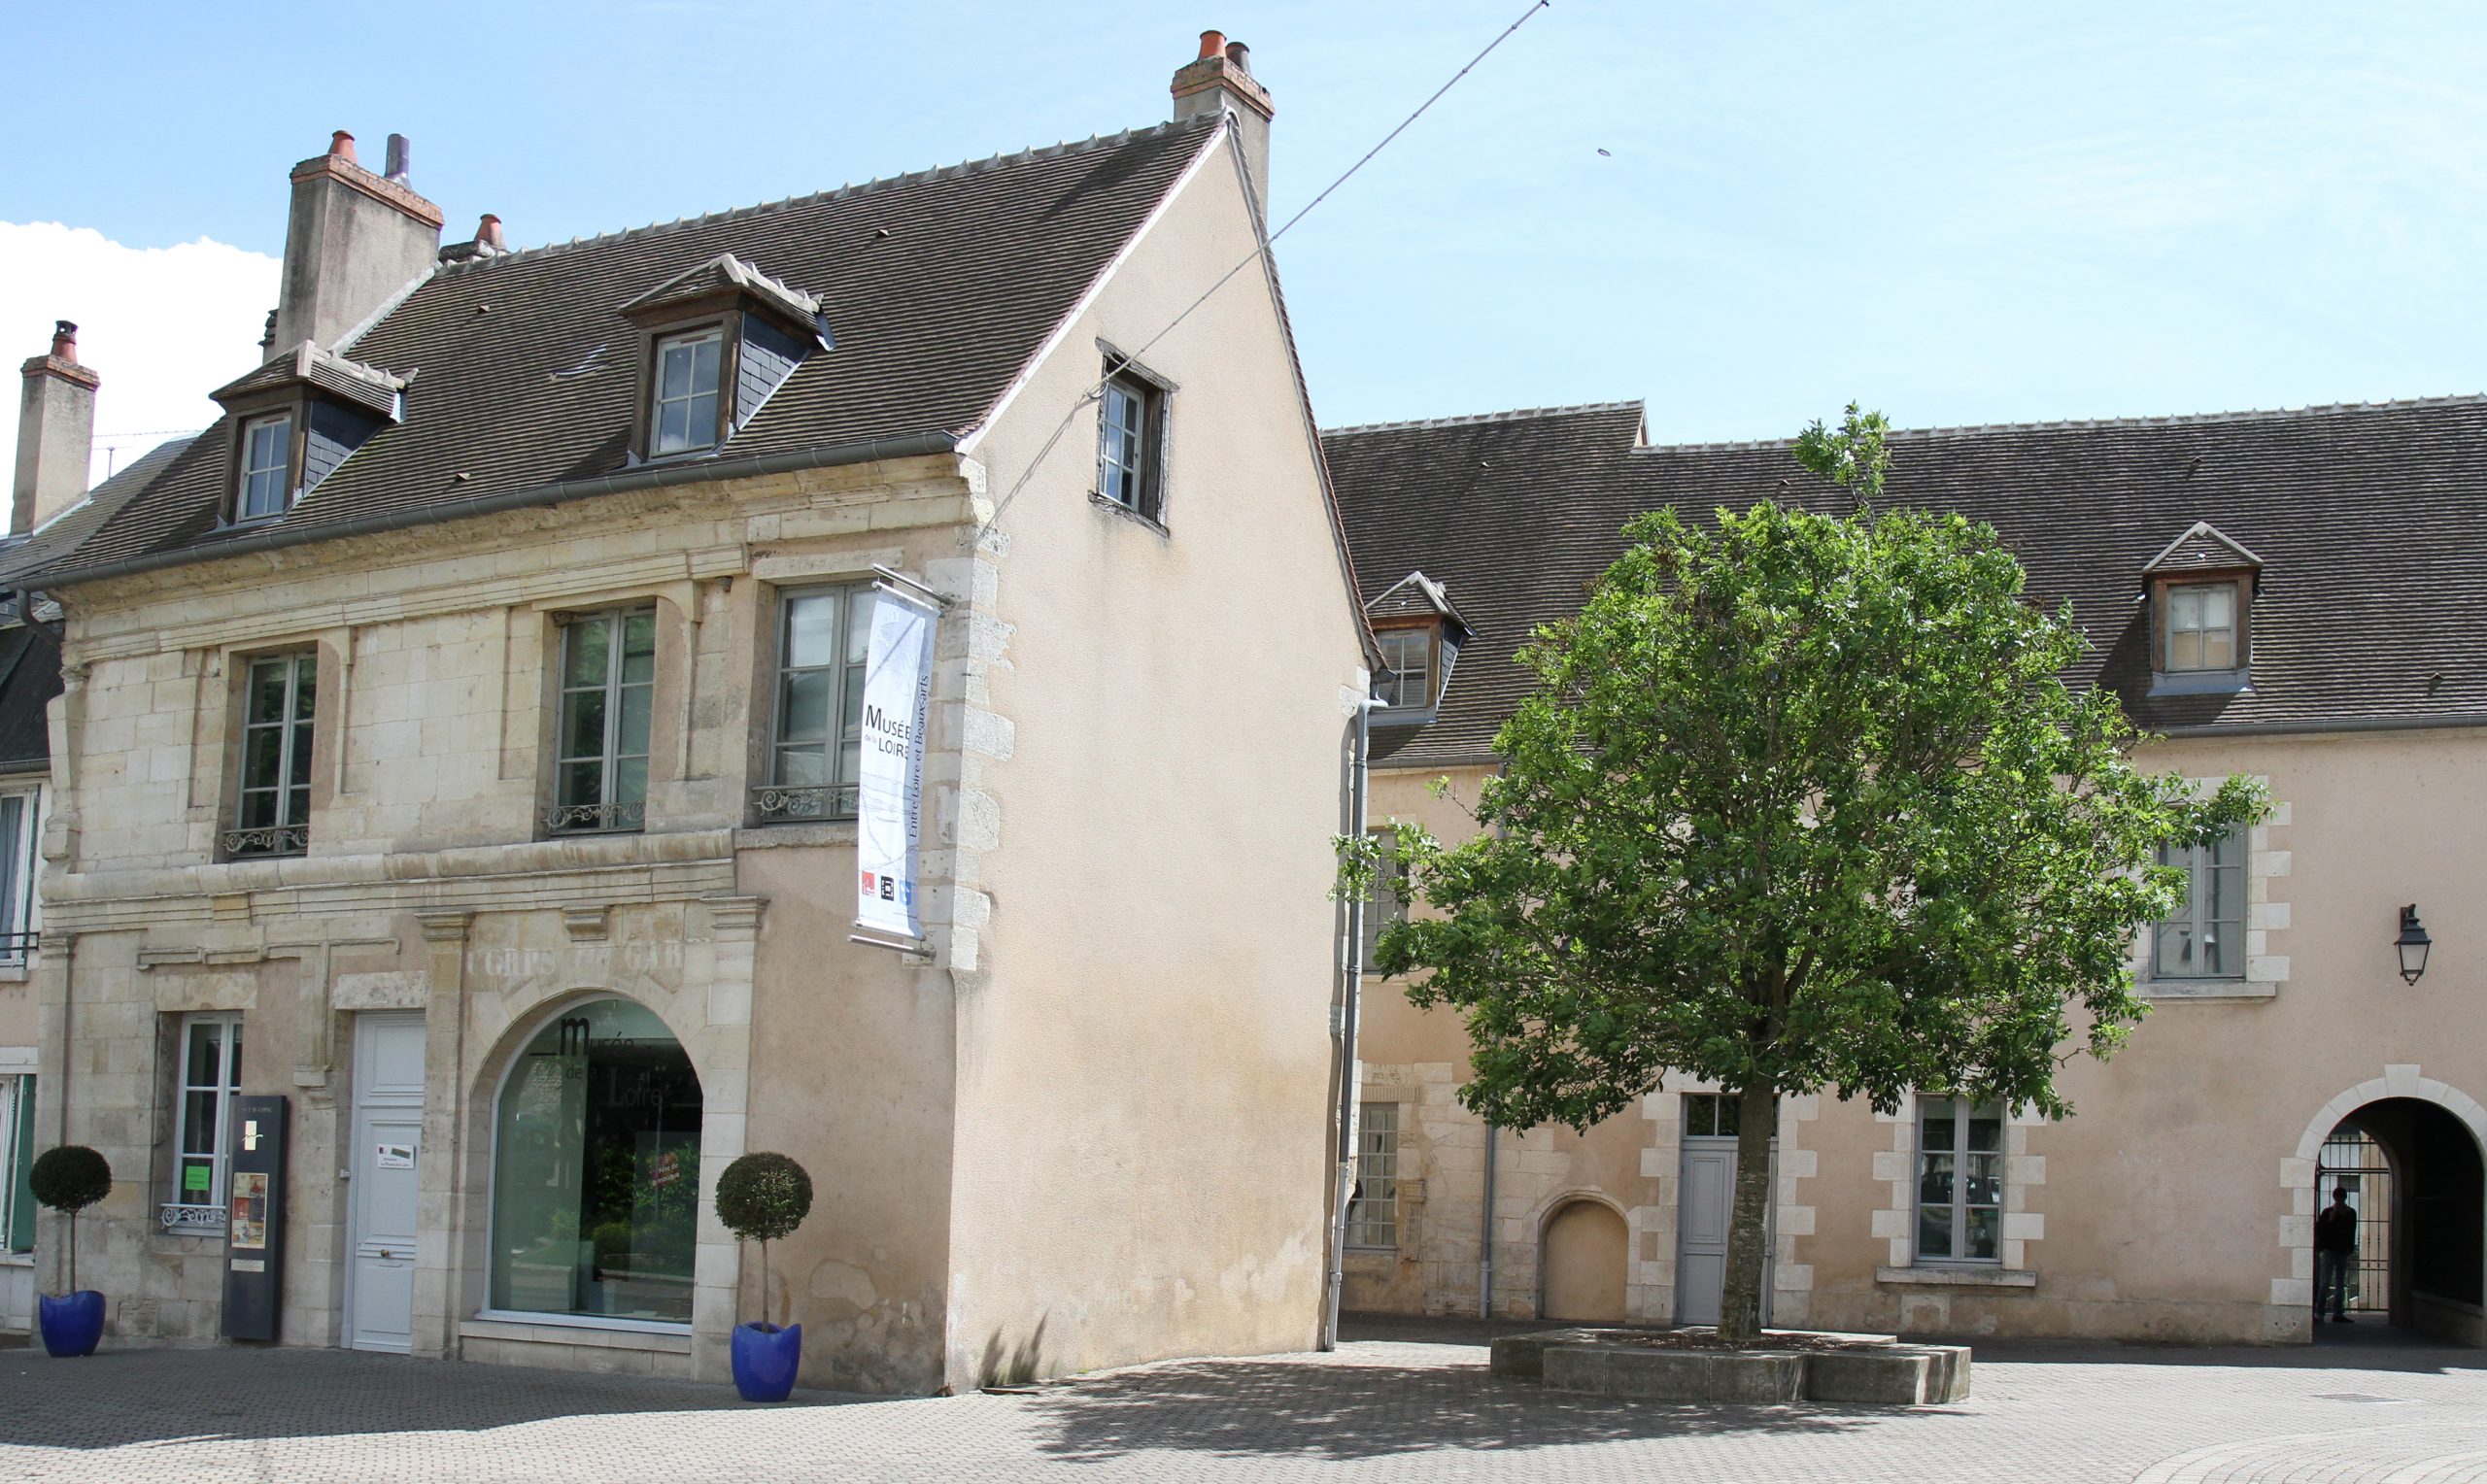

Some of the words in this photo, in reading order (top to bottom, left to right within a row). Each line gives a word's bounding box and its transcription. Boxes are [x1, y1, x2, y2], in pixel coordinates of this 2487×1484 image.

[866, 704, 911, 740] MUSÉE
[915, 675, 929, 745] Beaux-arts
[878, 737, 908, 760] LOIRE
[915, 749, 922, 761] et
[912, 764, 921, 797] Loire
[909, 801, 919, 837] Entre
[566, 1064, 583, 1080] de
